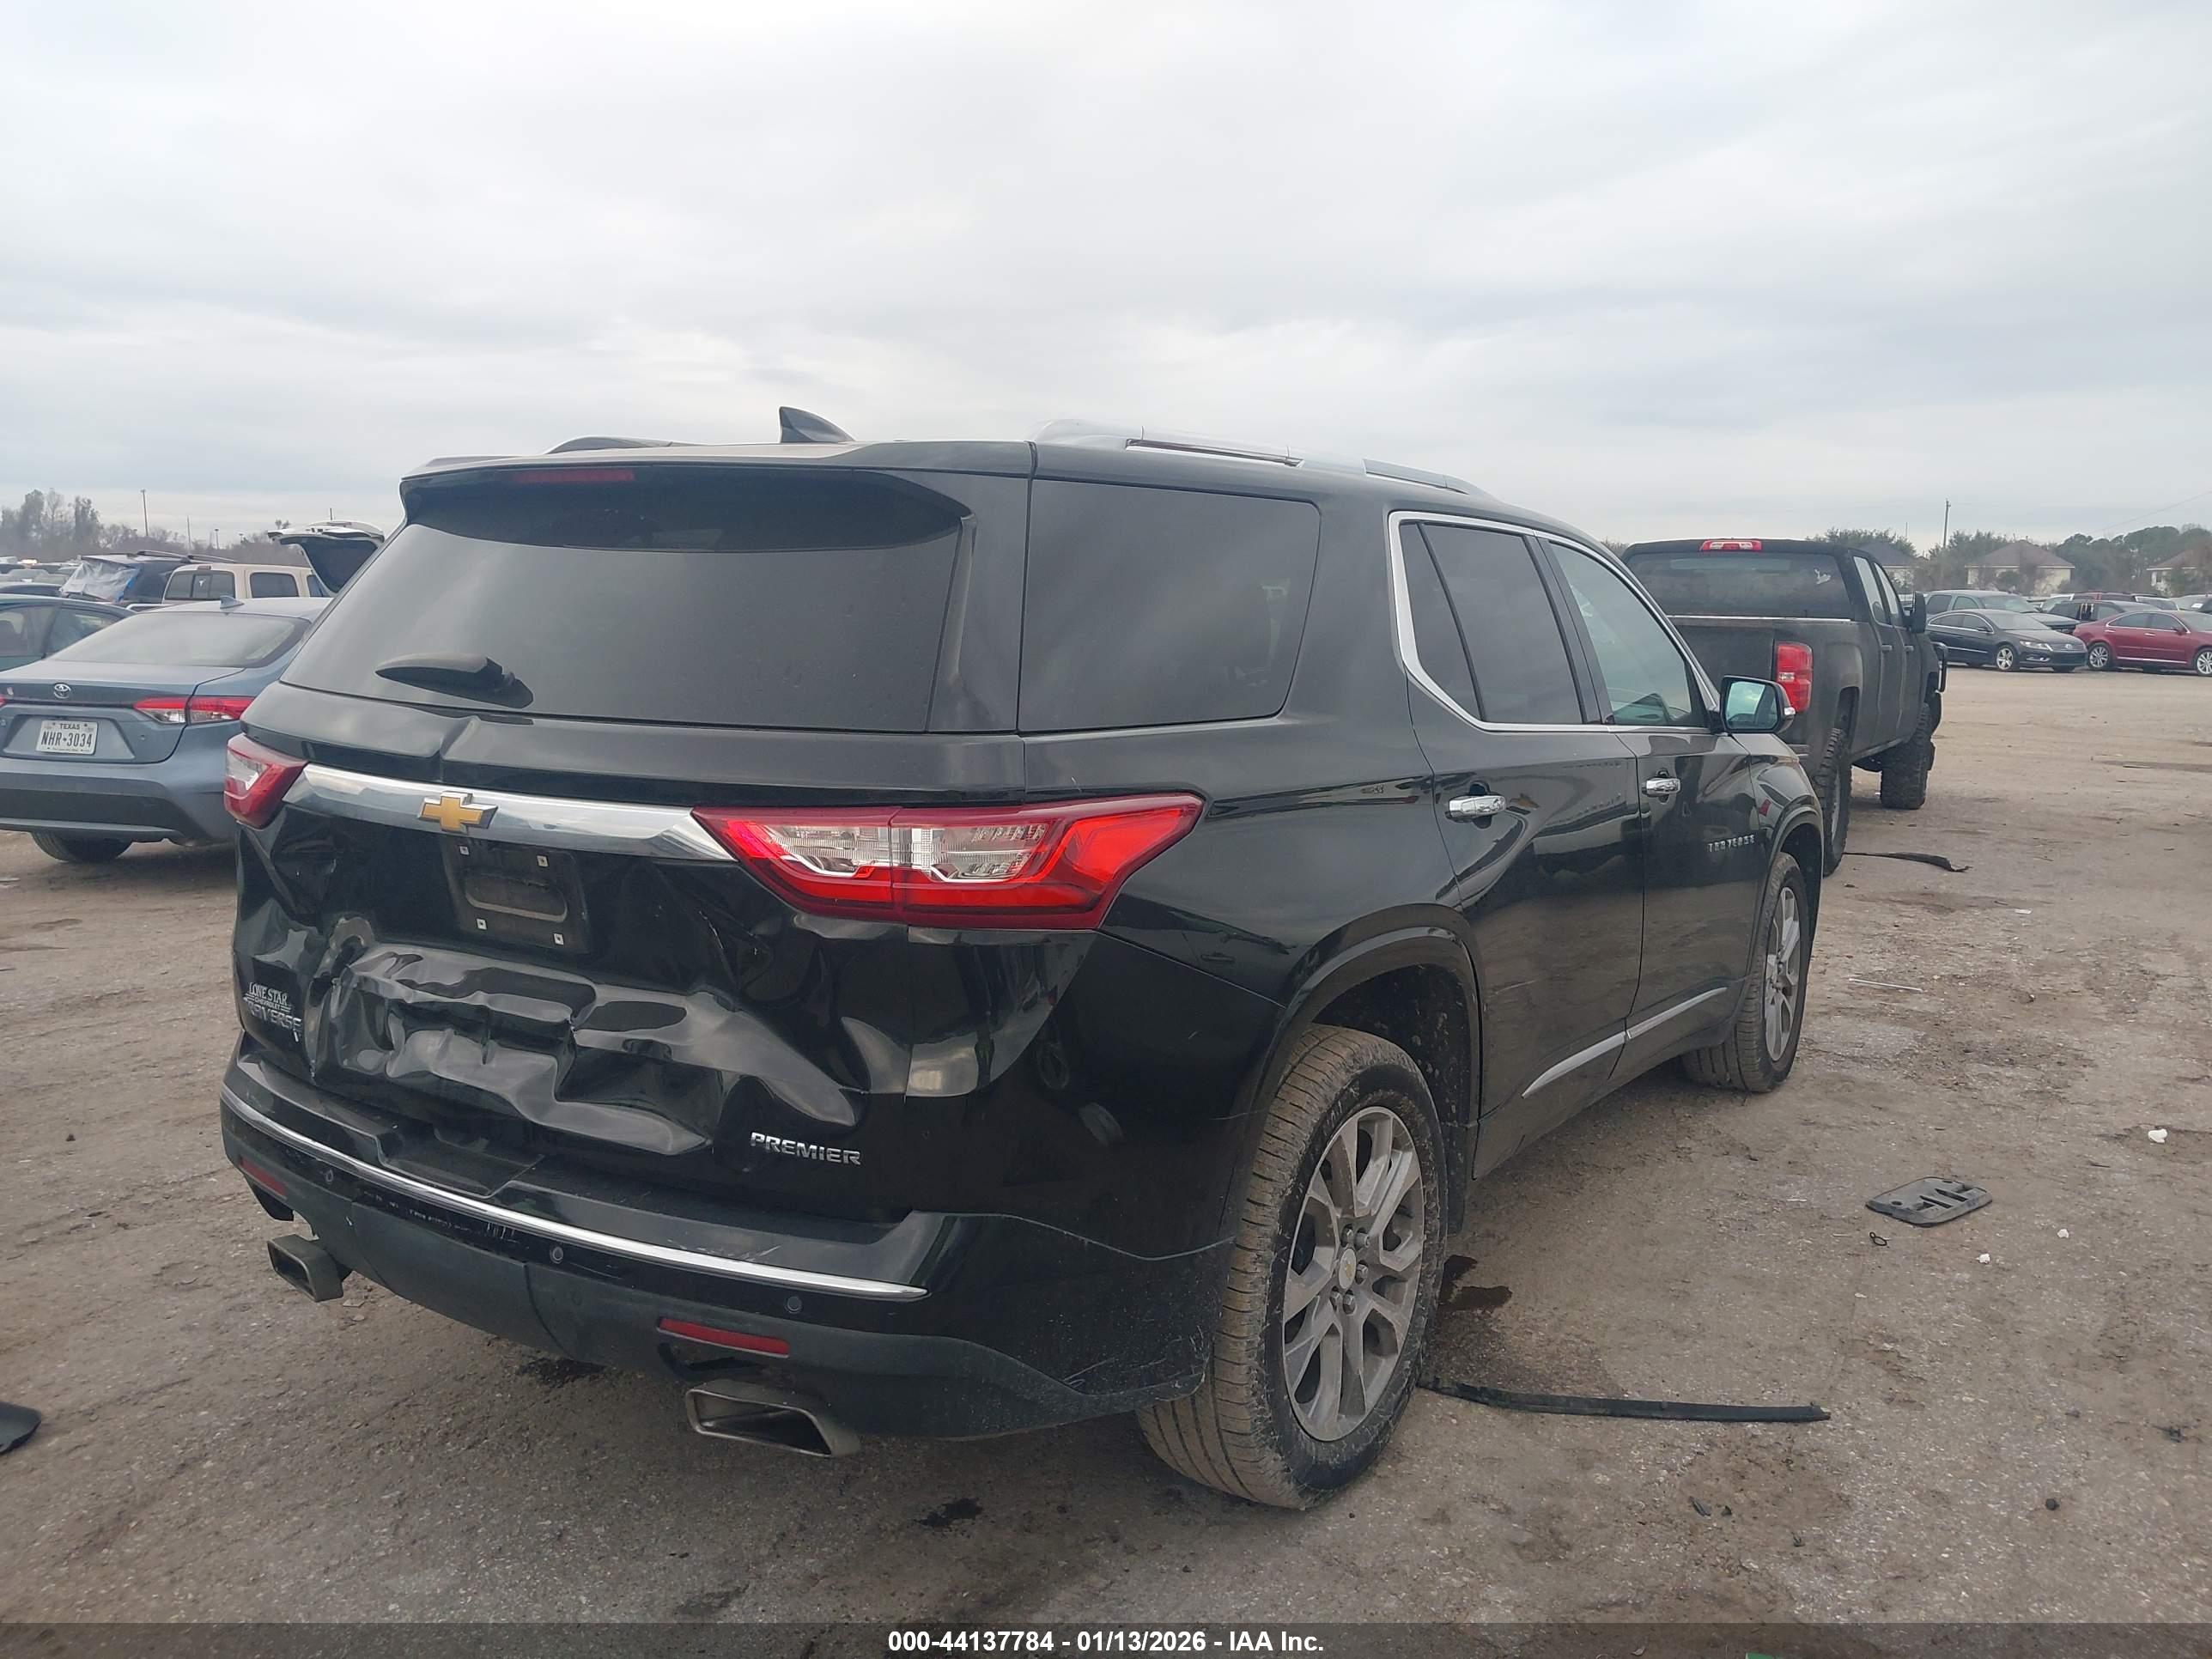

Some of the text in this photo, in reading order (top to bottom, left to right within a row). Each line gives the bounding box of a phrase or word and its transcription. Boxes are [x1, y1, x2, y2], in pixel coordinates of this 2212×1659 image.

[249, 981, 289, 1006] LONE STAR
[750, 1132, 861, 1165] PREMIER
